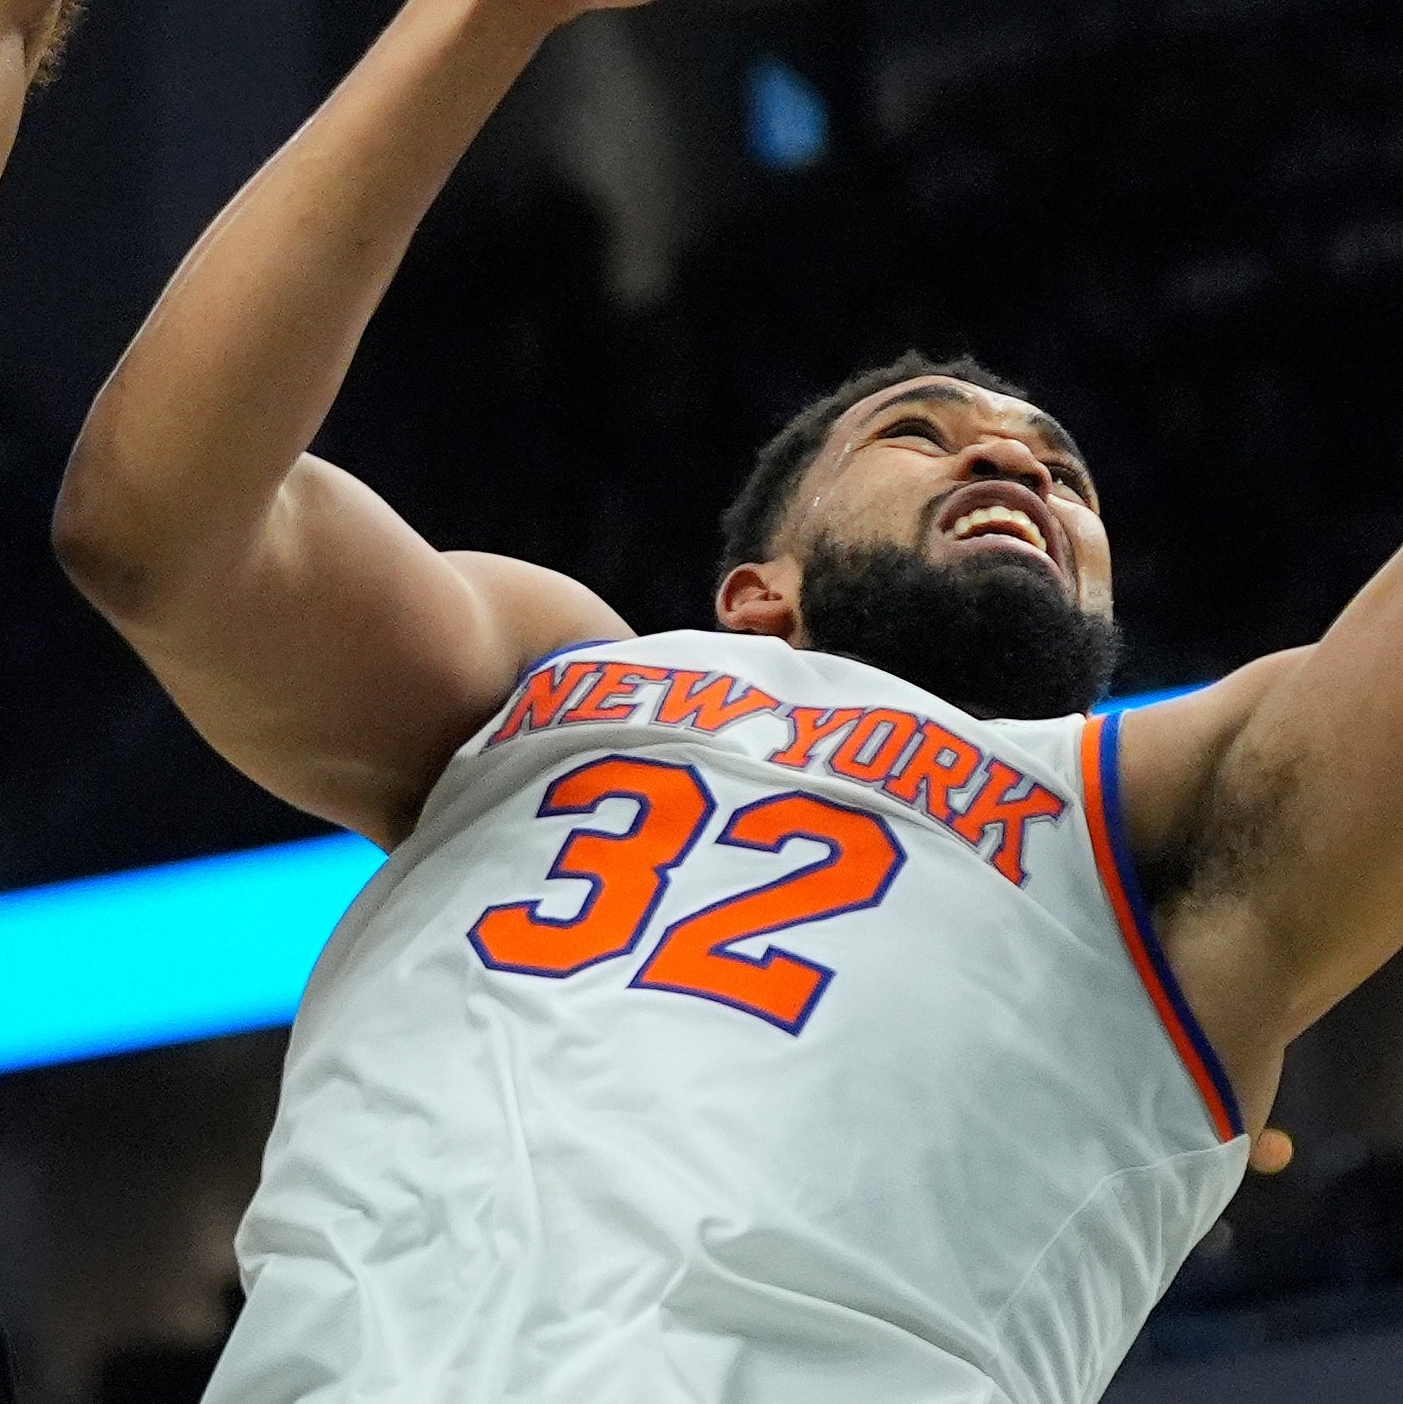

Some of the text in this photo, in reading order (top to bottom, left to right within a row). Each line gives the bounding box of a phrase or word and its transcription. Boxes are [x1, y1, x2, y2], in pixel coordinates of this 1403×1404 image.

[466, 753, 908, 1037] 32
[488, 660, 1070, 889] NEW YORK
